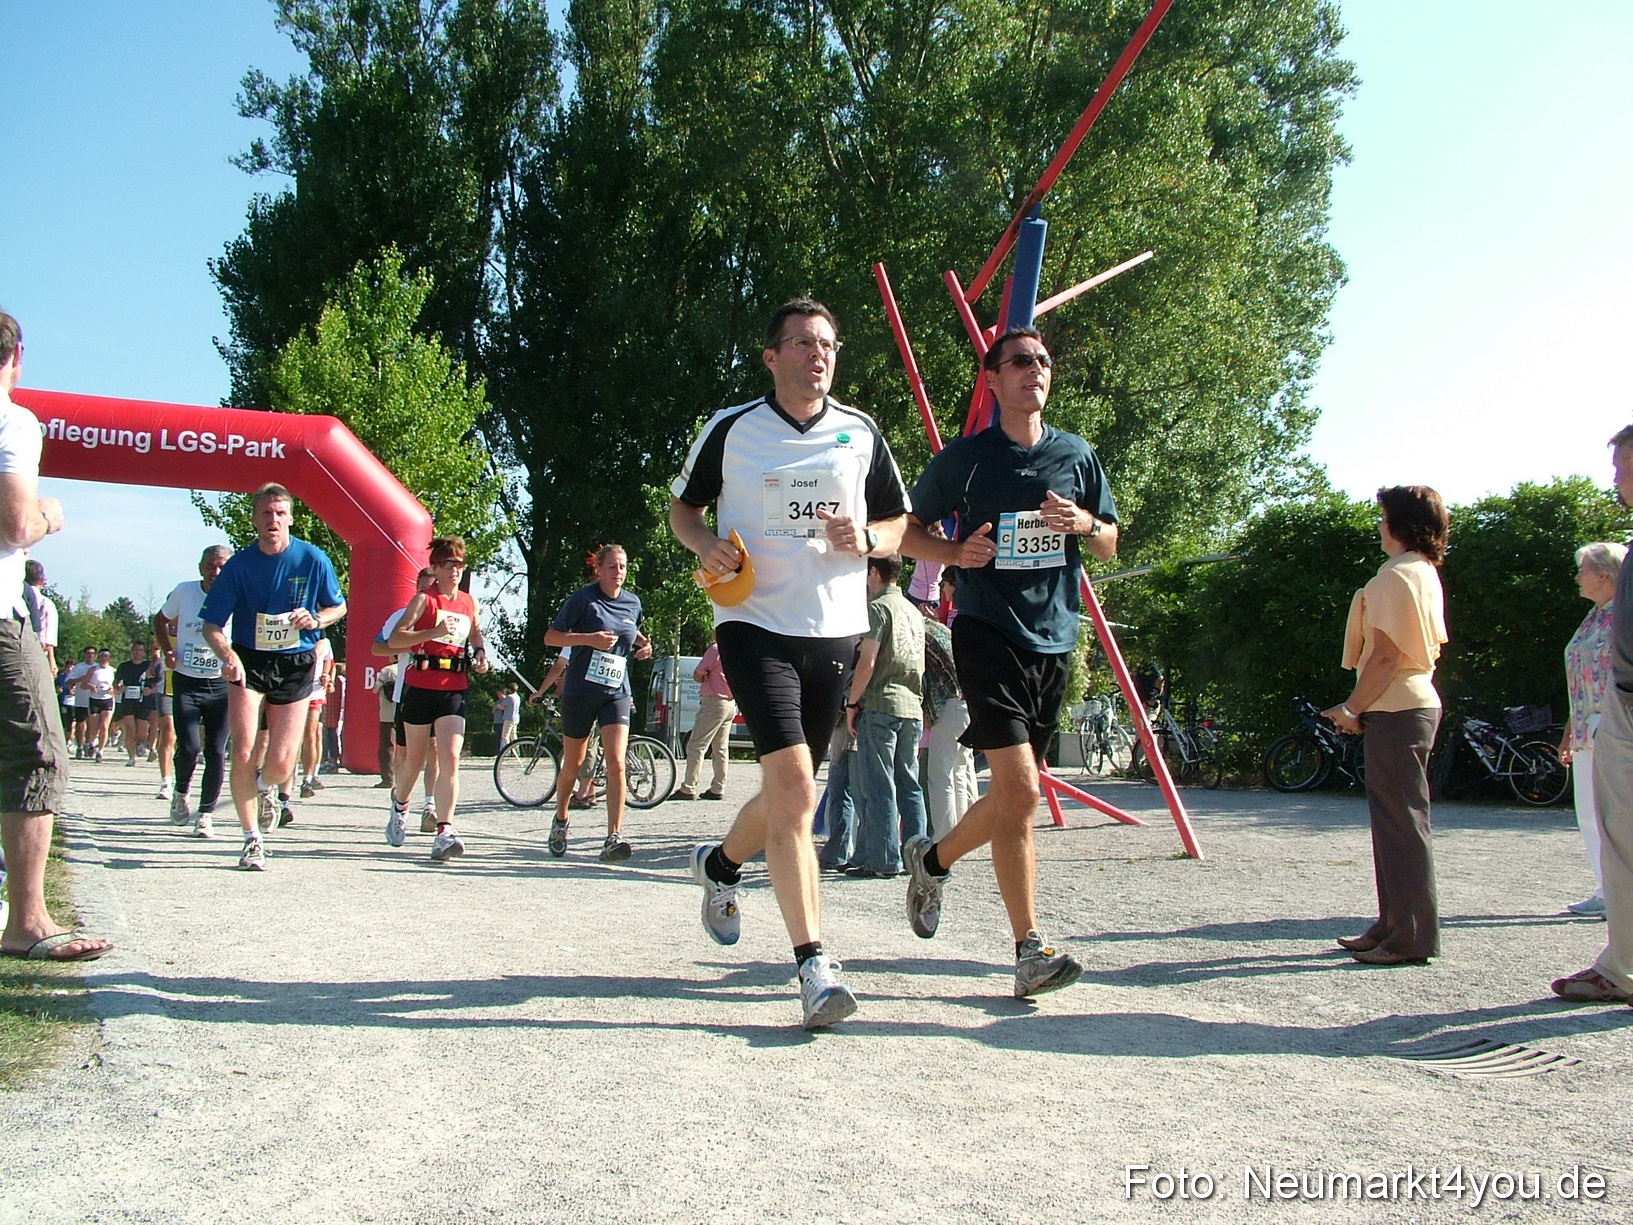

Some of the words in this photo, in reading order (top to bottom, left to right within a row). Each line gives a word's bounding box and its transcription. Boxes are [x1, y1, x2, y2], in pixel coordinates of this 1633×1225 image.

[160, 428, 286, 459] LGS-Park
[790, 478, 819, 488] Josef
[788, 501, 840, 520] 3467
[1002, 534, 1010, 543] C
[1017, 534, 1061, 554] 3355
[266, 629, 289, 641] 707
[192, 656, 219, 668] 2988
[598, 665, 622, 679] 3160
